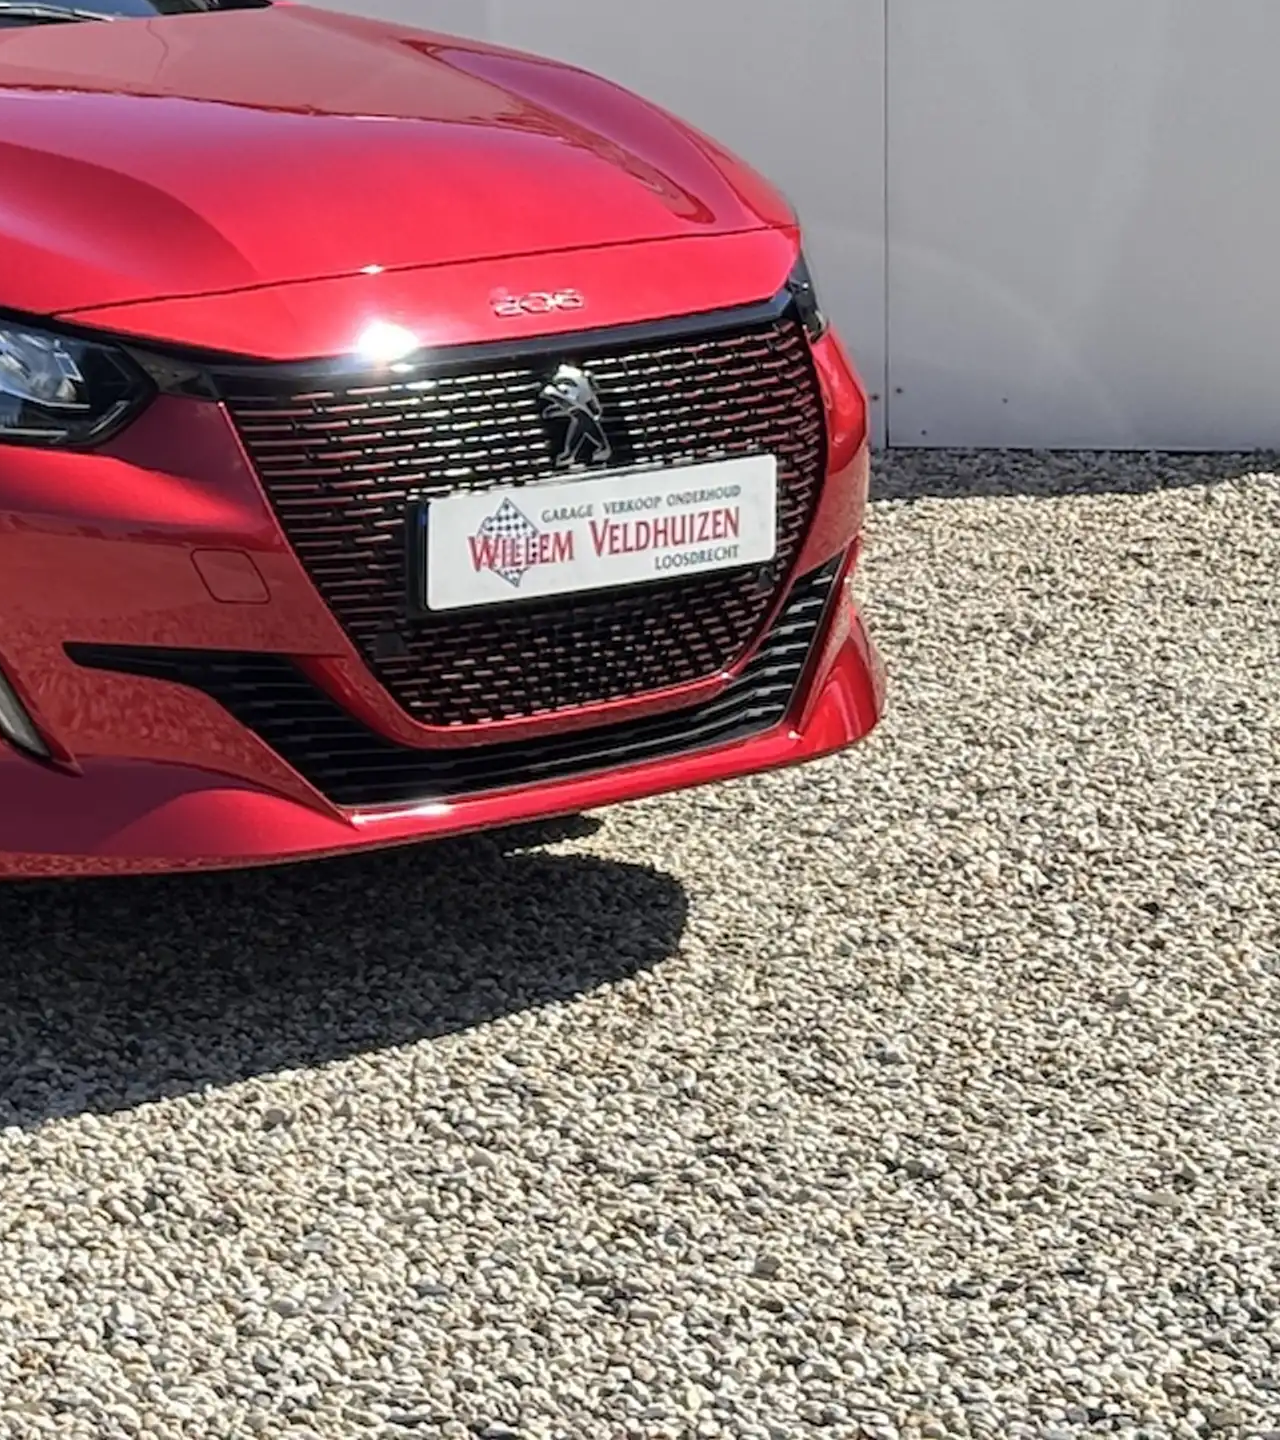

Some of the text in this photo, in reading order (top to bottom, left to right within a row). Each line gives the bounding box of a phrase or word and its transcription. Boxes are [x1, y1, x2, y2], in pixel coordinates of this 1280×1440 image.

[542, 485, 741, 523] GARAGE VERKOOP ONDERHOUD
[468, 506, 740, 572] WILLEM VELDHUIZEN
[655, 545, 739, 571] LOOSDRECHT
